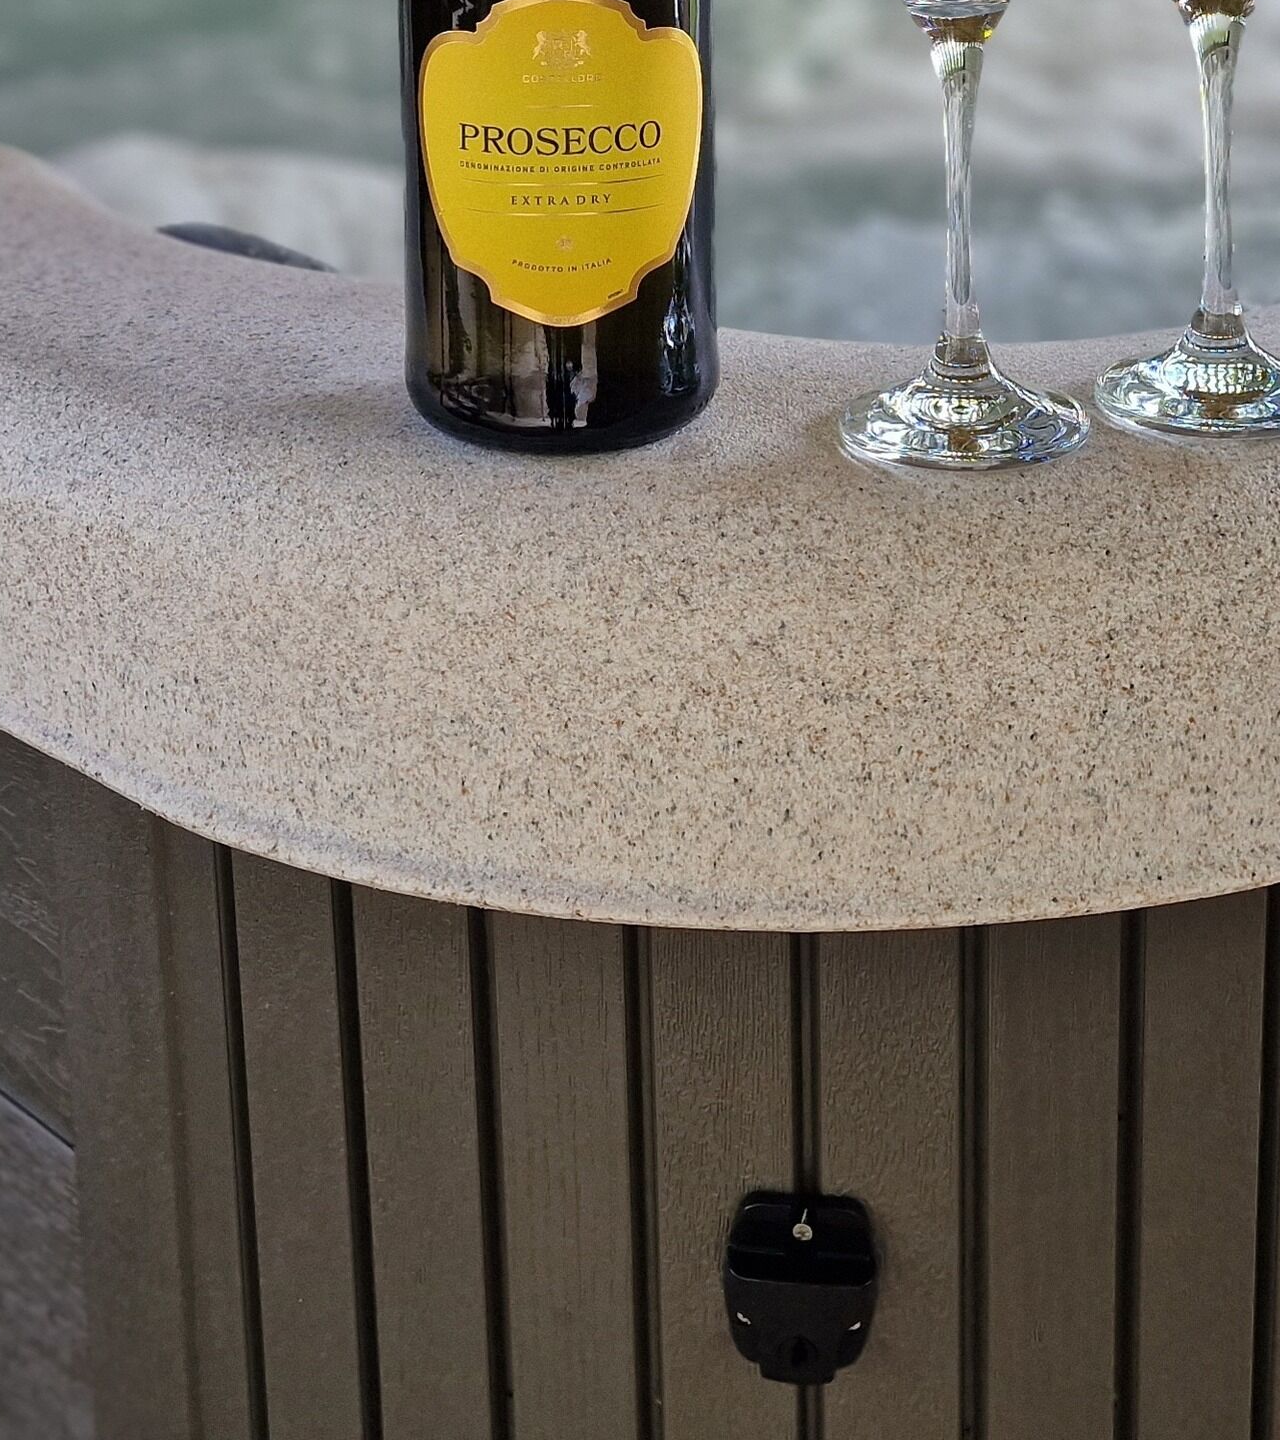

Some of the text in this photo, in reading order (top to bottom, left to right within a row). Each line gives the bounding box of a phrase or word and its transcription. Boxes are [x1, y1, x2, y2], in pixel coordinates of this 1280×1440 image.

[458, 120, 662, 156] PROSECCO
[459, 157, 661, 173] DENOMINAZIONE DI ORIGINE CONTROLLATA
[511, 193, 613, 206] EXTRA DRY
[511, 258, 564, 273] PRODOTTO
[581, 257, 613, 271] ITALIA
